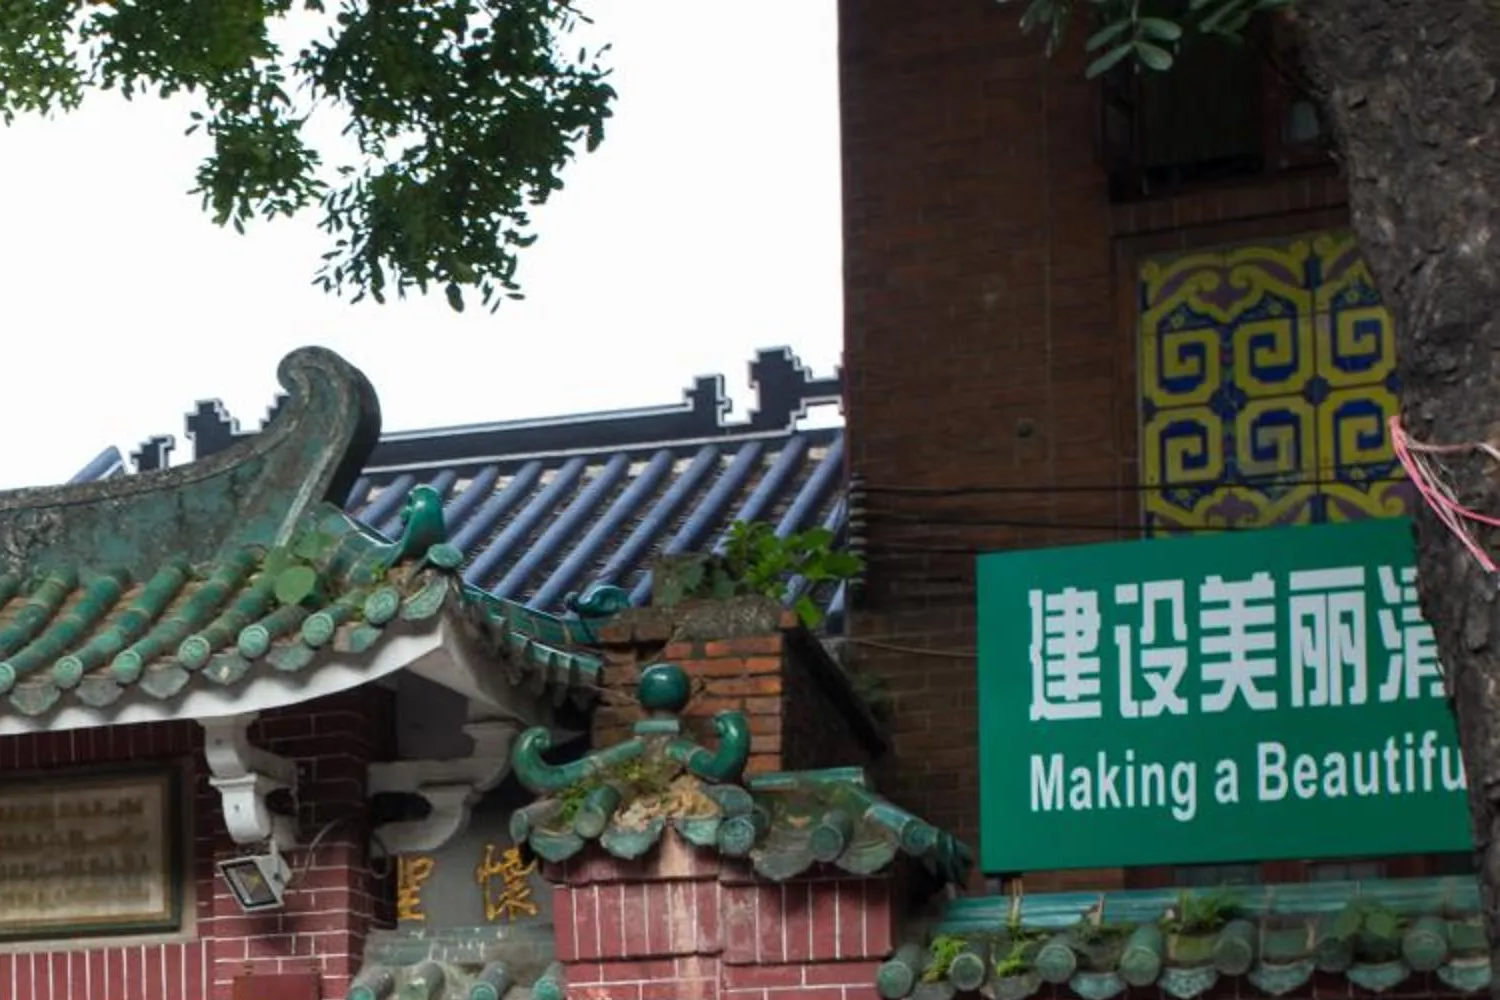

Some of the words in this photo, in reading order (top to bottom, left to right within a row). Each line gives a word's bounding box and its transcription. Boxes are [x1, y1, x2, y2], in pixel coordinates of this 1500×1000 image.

[1029, 566, 1447, 721] 建设美丽清
[1030, 749, 1197, 822] Making
[1214, 757, 1239, 804] a
[1257, 730, 1468, 802] Beautifu
